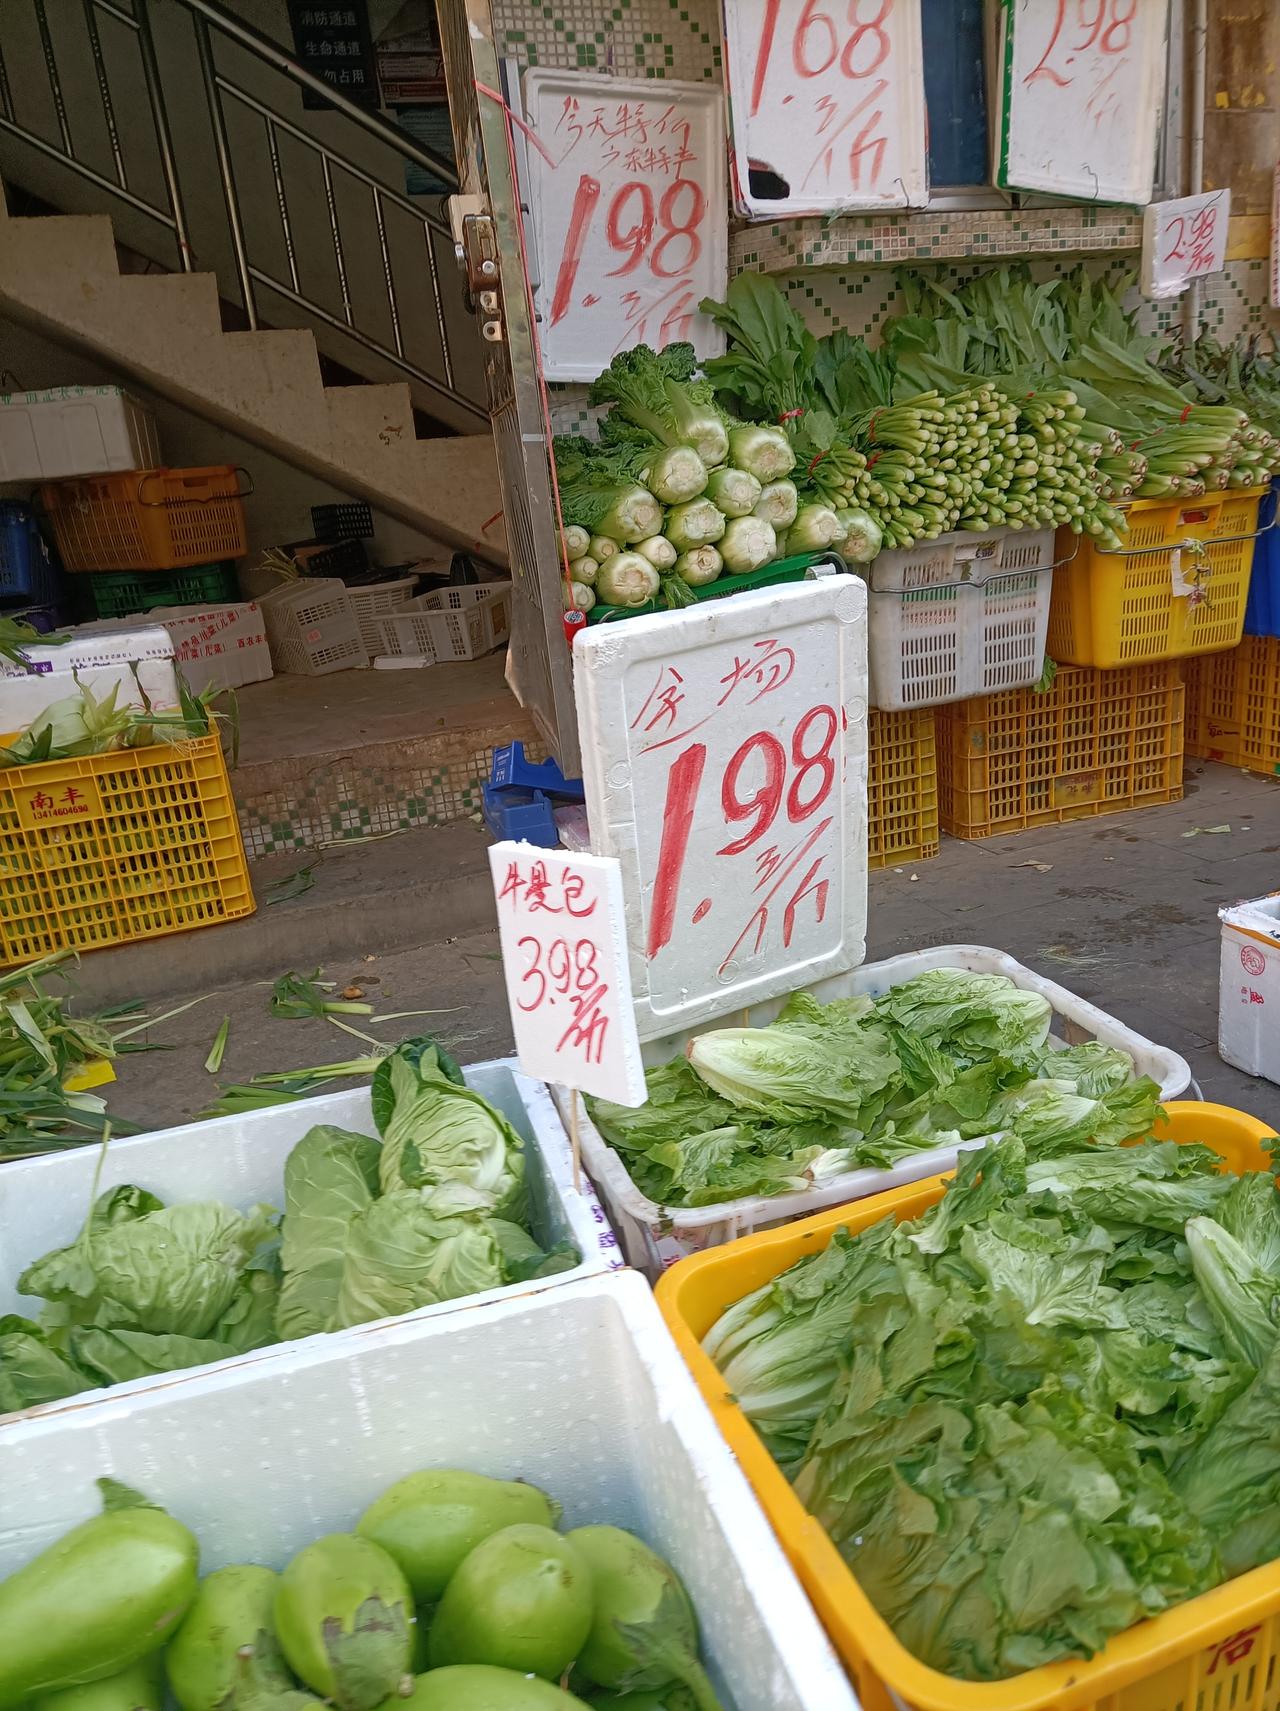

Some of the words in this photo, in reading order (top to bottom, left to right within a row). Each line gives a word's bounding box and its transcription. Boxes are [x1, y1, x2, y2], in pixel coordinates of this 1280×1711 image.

[304, 39, 363, 57] 生命通道
[322, 68, 366, 84] 勿占用
[29, 786, 86, 811] 南丰
[646, 704, 838, 961] 1.98
[516, 935, 600, 1012] 3.98
